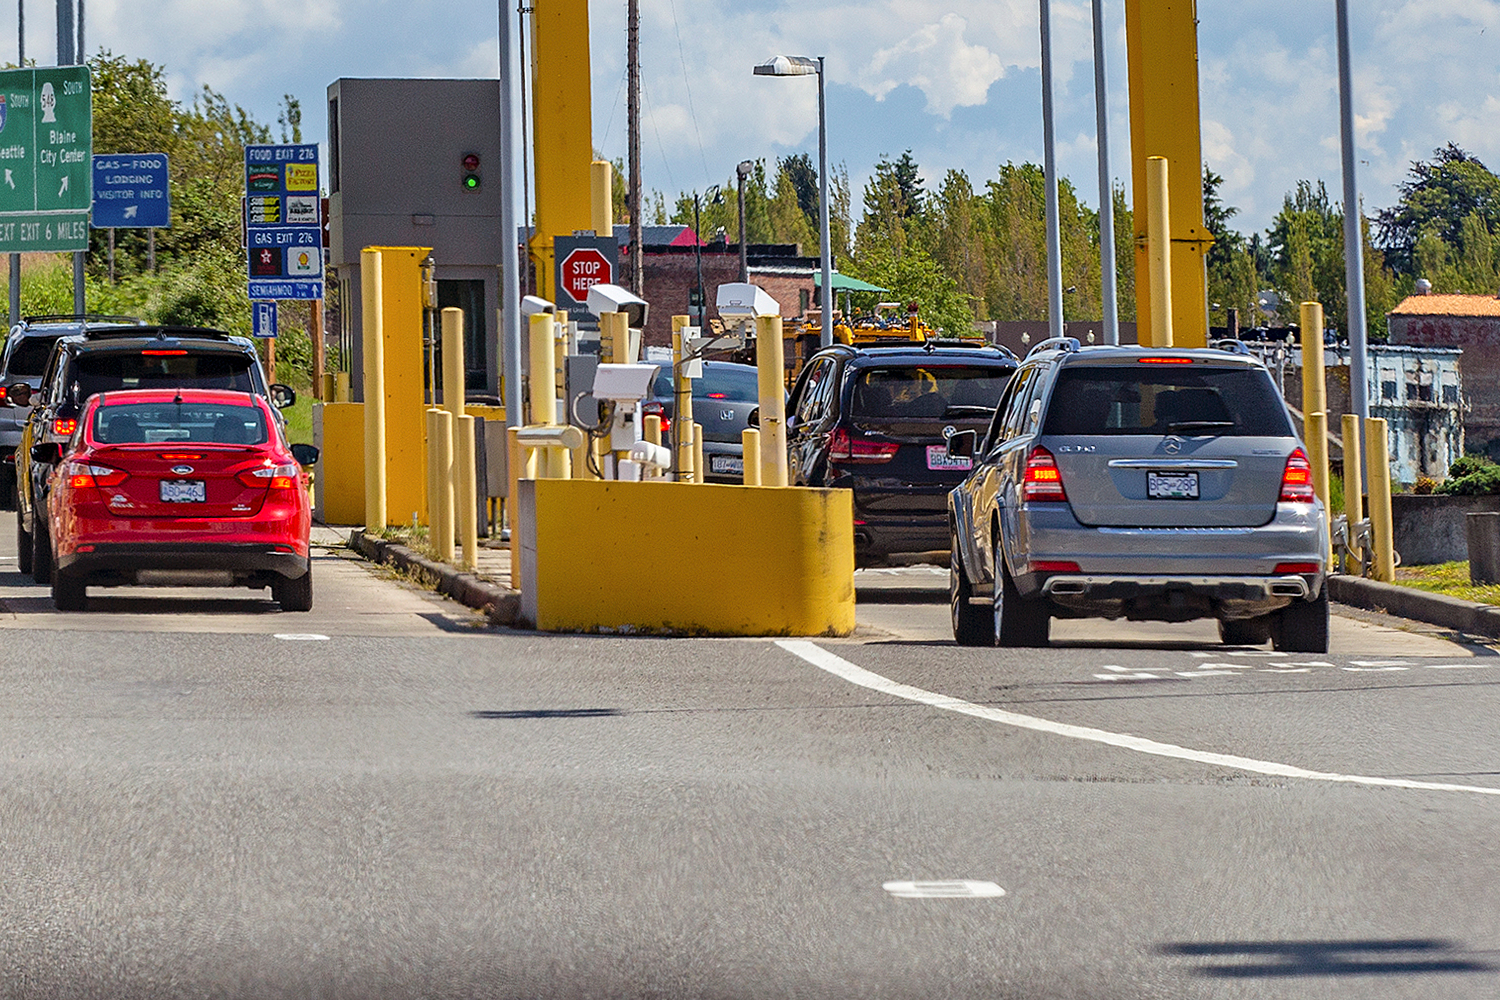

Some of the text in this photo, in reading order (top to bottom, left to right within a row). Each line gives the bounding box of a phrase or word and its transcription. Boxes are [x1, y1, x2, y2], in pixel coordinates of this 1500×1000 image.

[50, 130, 76, 144] Blaine
[41, 148, 86, 167] City Center
[249, 148, 314, 160] FOOD EXIT 276
[96, 160, 162, 170] GAS FOOD
[105, 175, 153, 185] LODGING
[97, 190, 163, 199] VISITOR INFO
[20, 222, 41, 241] EXIT
[45, 222, 52, 240] 6
[57, 221, 86, 241] MILES
[255, 232, 313, 244] GAS EXIT 276
[572, 261, 601, 275] STOP
